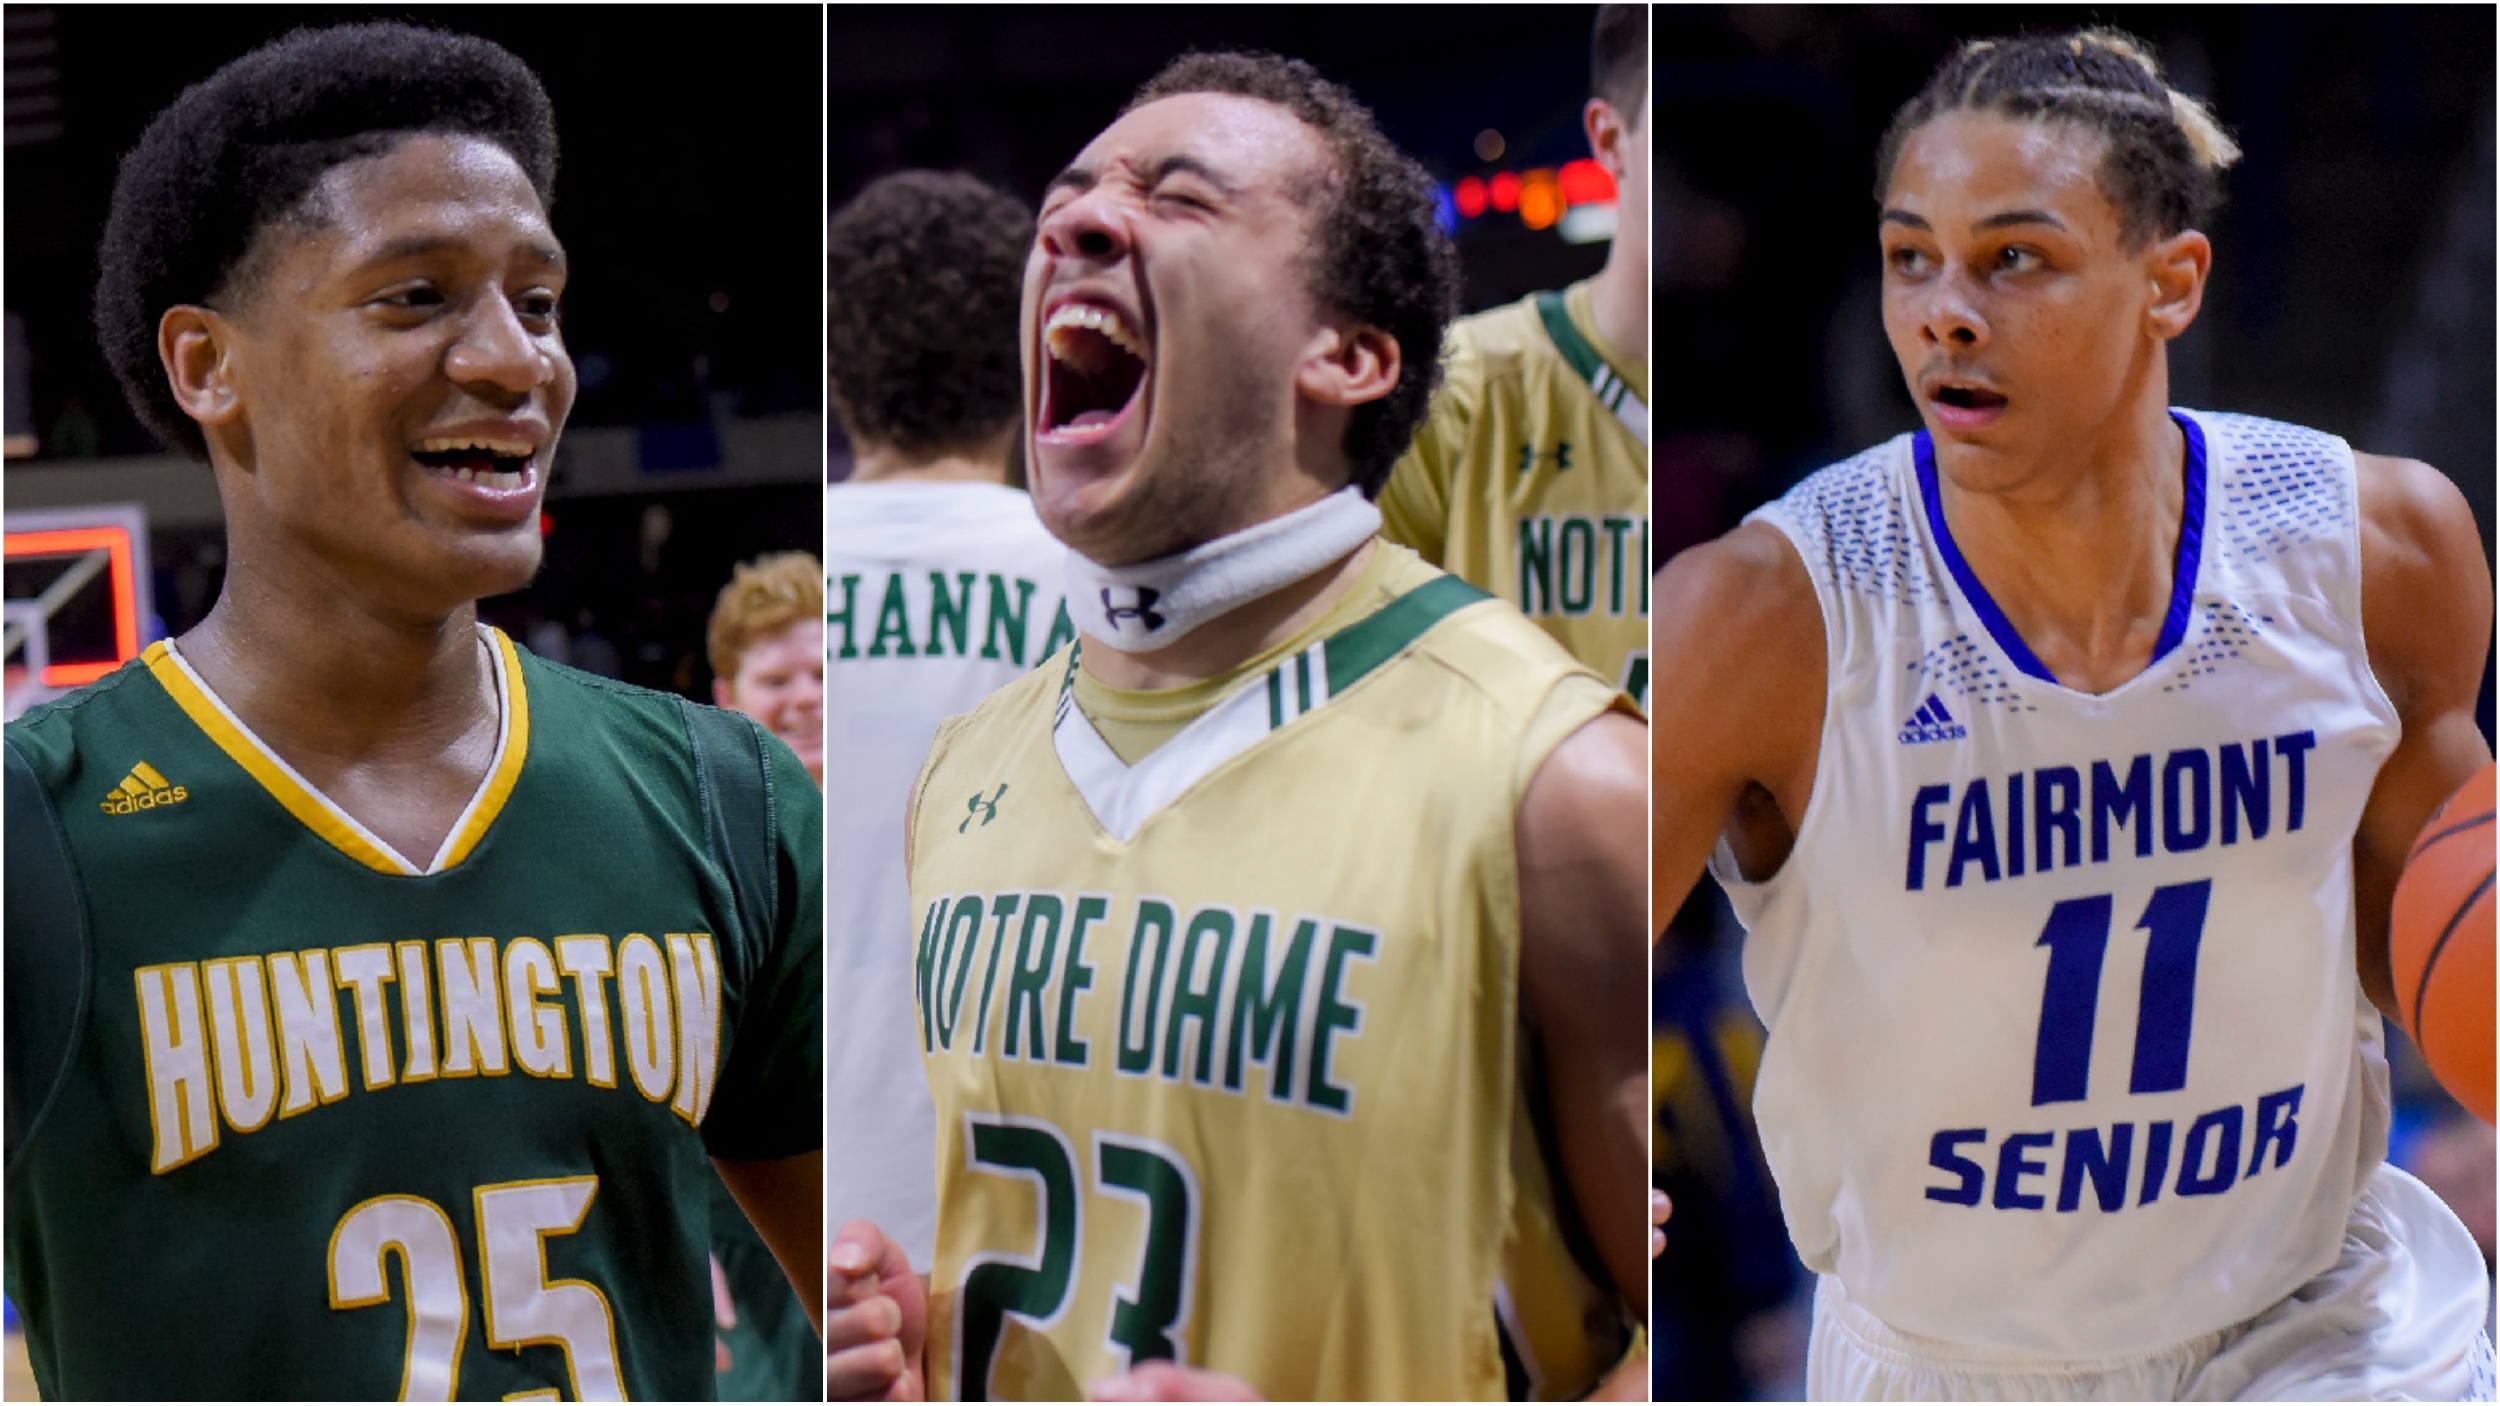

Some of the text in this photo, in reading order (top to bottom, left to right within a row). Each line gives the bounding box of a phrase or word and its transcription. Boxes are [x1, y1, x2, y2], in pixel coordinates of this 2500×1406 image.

[1516, 515, 1648, 618] NOT
[100, 785, 188, 815] adidas
[1897, 724, 1967, 744] adidas
[1905, 729, 2316, 891] FAIRMONT
[134, 932, 722, 1175] HUNTINGTON
[915, 892, 1381, 1118] NOTRE DAME
[2031, 877, 2212, 1107] 11
[1925, 1083, 2306, 1213] SENIOR
[327, 1174, 628, 1402] 25
